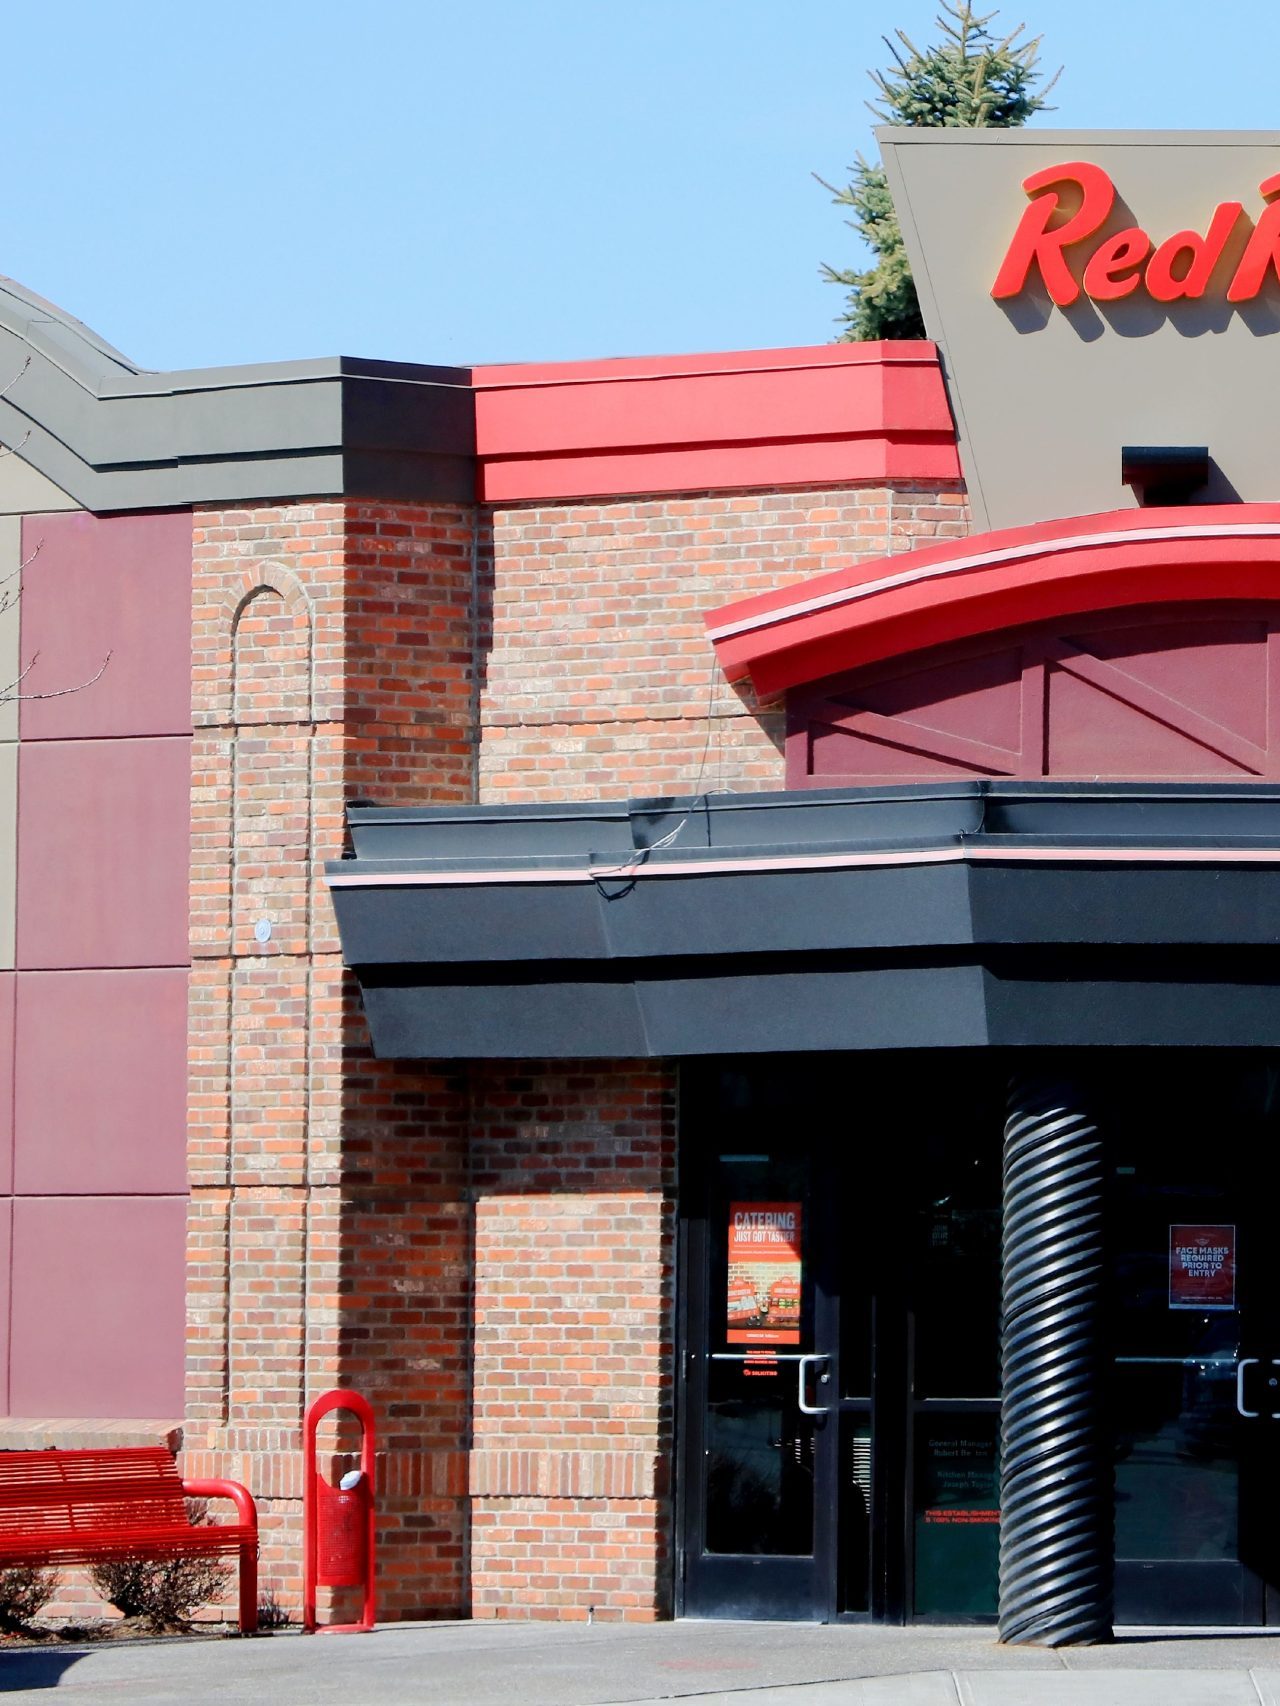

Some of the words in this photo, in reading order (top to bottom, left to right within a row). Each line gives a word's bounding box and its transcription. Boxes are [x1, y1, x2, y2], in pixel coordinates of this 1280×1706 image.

[991, 161, 1242, 308] Red
[734, 1212, 795, 1230] CATERING
[734, 1231, 751, 1242] JUST
[752, 1231, 766, 1242] GOT
[768, 1231, 795, 1242] TASTIER
[1188, 1269, 1216, 1277] ENTRY
